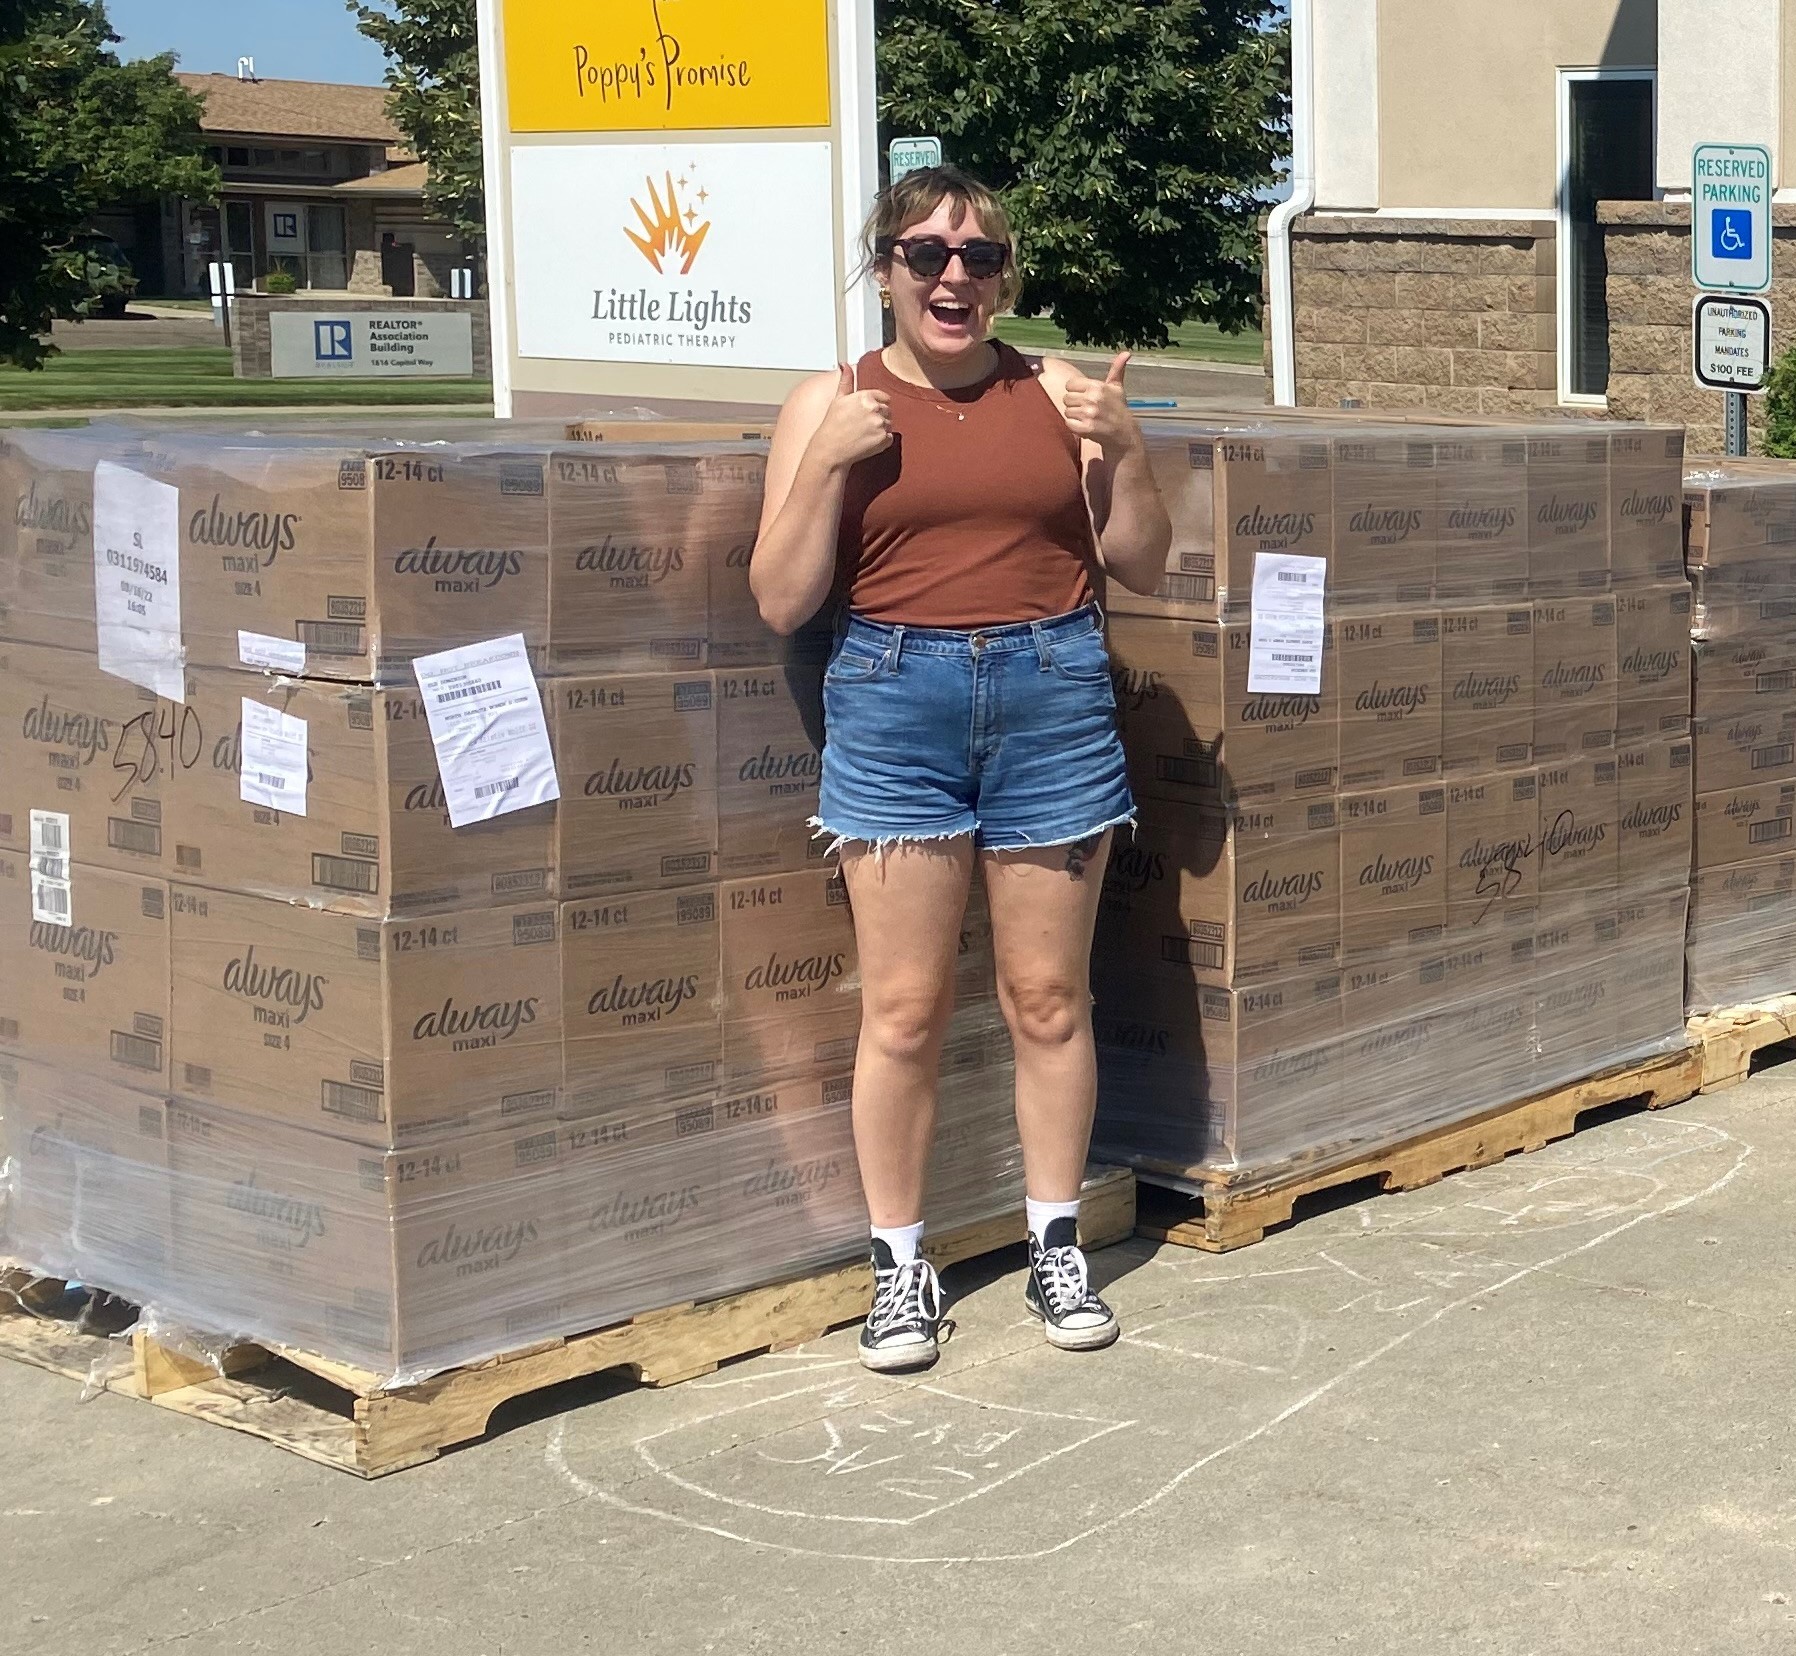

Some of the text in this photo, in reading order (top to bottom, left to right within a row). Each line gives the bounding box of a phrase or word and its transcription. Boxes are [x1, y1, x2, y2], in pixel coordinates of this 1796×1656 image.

[573, 30, 751, 110] Poppy's Promise
[893, 151, 938, 167] RESERVED
[1698, 158, 1765, 178] RESERVED
[1703, 183, 1761, 203] PARKING
[591, 288, 751, 331] Little Lights
[1707, 306, 1758, 321] UNAUTHORIZED
[370, 332, 429, 341] Association
[609, 332, 736, 348] PEDIATRIC THERAPY
[1718, 327, 1747, 339] PARKING
[370, 343, 414, 354] Building
[1715, 346, 1750, 358] MANDATES
[390, 359, 417, 368] Capitol
[418, 359, 434, 367] Way
[1737, 365, 1754, 376] FEE
[1223, 446, 1265, 462] 12-14 ct
[375, 460, 445, 482] 12-14 ct
[1537, 494, 1598, 530] always
[1621, 489, 1674, 521] always
[190, 494, 303, 566] always
[1236, 505, 1315, 544] always
[1350, 504, 1422, 540] always
[1260, 539, 1288, 550] maxi
[107, 549, 168, 585] 0311974584
[395, 535, 524, 588] always
[576, 535, 685, 584] always
[434, 578, 479, 594] maxi
[1344, 625, 1383, 641] 12-14 ct
[1622, 647, 1680, 677] always
[1542, 660, 1605, 691] always
[723, 679, 775, 699] 12-14 ct
[1356, 681, 1428, 715] always
[1453, 672, 1521, 704] always
[1242, 695, 1320, 730] always
[1377, 713, 1402, 722] maxi
[1265, 722, 1295, 734] maxi
[584, 758, 696, 802] always
[769, 782, 805, 795] maxi
[619, 793, 659, 810] maxi
[1234, 814, 1274, 832] 12-14 ct
[1621, 801, 1682, 832] always
[1360, 854, 1434, 887] always
[730, 887, 783, 909] 12-14 ct
[1243, 870, 1324, 904] always
[1382, 884, 1408, 895] maxi
[571, 907, 628, 929] 12-14 ct
[1267, 901, 1296, 913] maxi
[394, 927, 458, 952] 12-14 ct
[745, 951, 846, 991] always
[224, 944, 330, 1024] always
[587, 974, 699, 1016] always
[775, 985, 812, 1002] maxi
[1244, 991, 1284, 1012] 12-14 ct
[253, 1004, 290, 1029] maxi
[412, 996, 539, 1040] always
[622, 1009, 662, 1027] maxi
[452, 1034, 498, 1053] maxi
[725, 1094, 779, 1119] 12-14 ct
[417, 1217, 539, 1268] always
